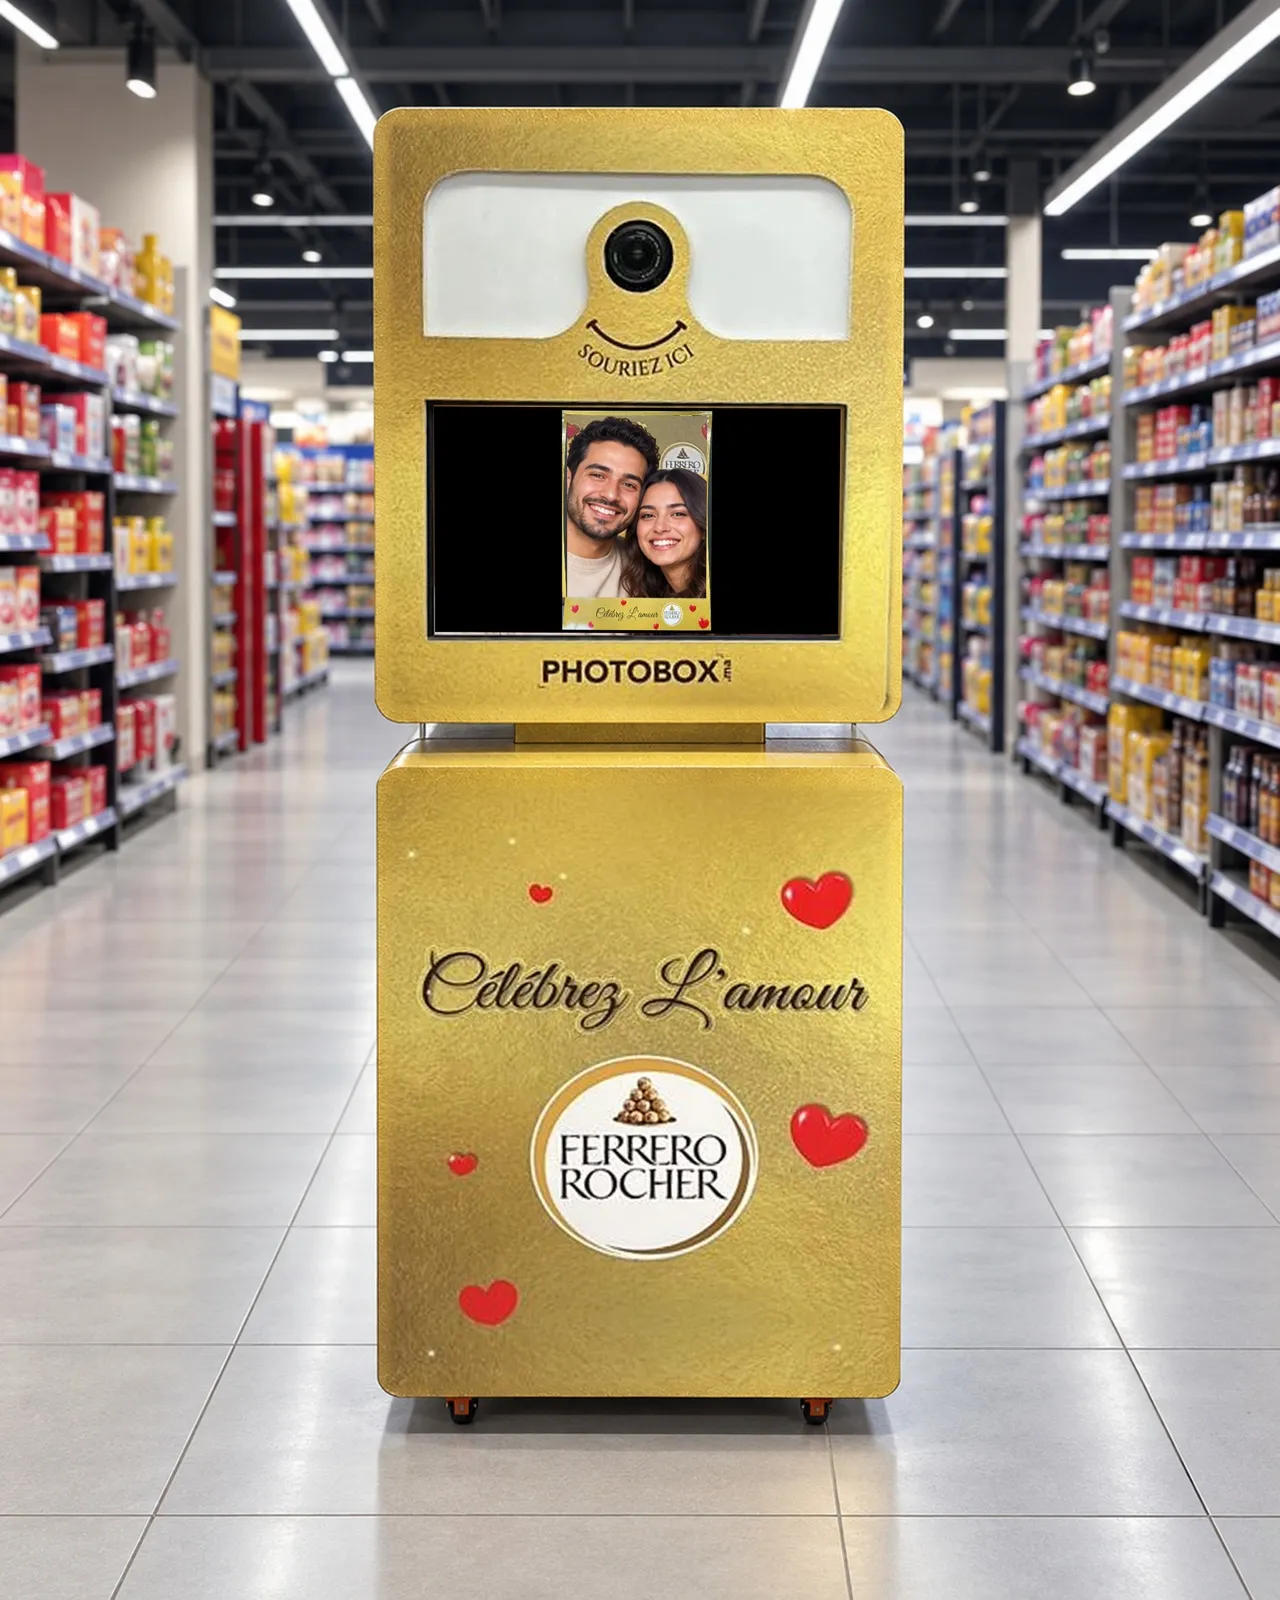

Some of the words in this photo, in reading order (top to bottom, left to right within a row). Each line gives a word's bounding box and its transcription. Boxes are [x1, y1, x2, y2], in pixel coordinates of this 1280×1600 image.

[578, 343, 663, 377] SOURIEZ
[665, 344, 694, 368] ICI
[543, 660, 719, 683] PHOTOBOX
[423, 950, 627, 1030] Célébrez
[641, 948, 869, 1030] L'amour
[560, 1134, 727, 1166] FERRERO
[560, 1168, 727, 1200] ROCHER
